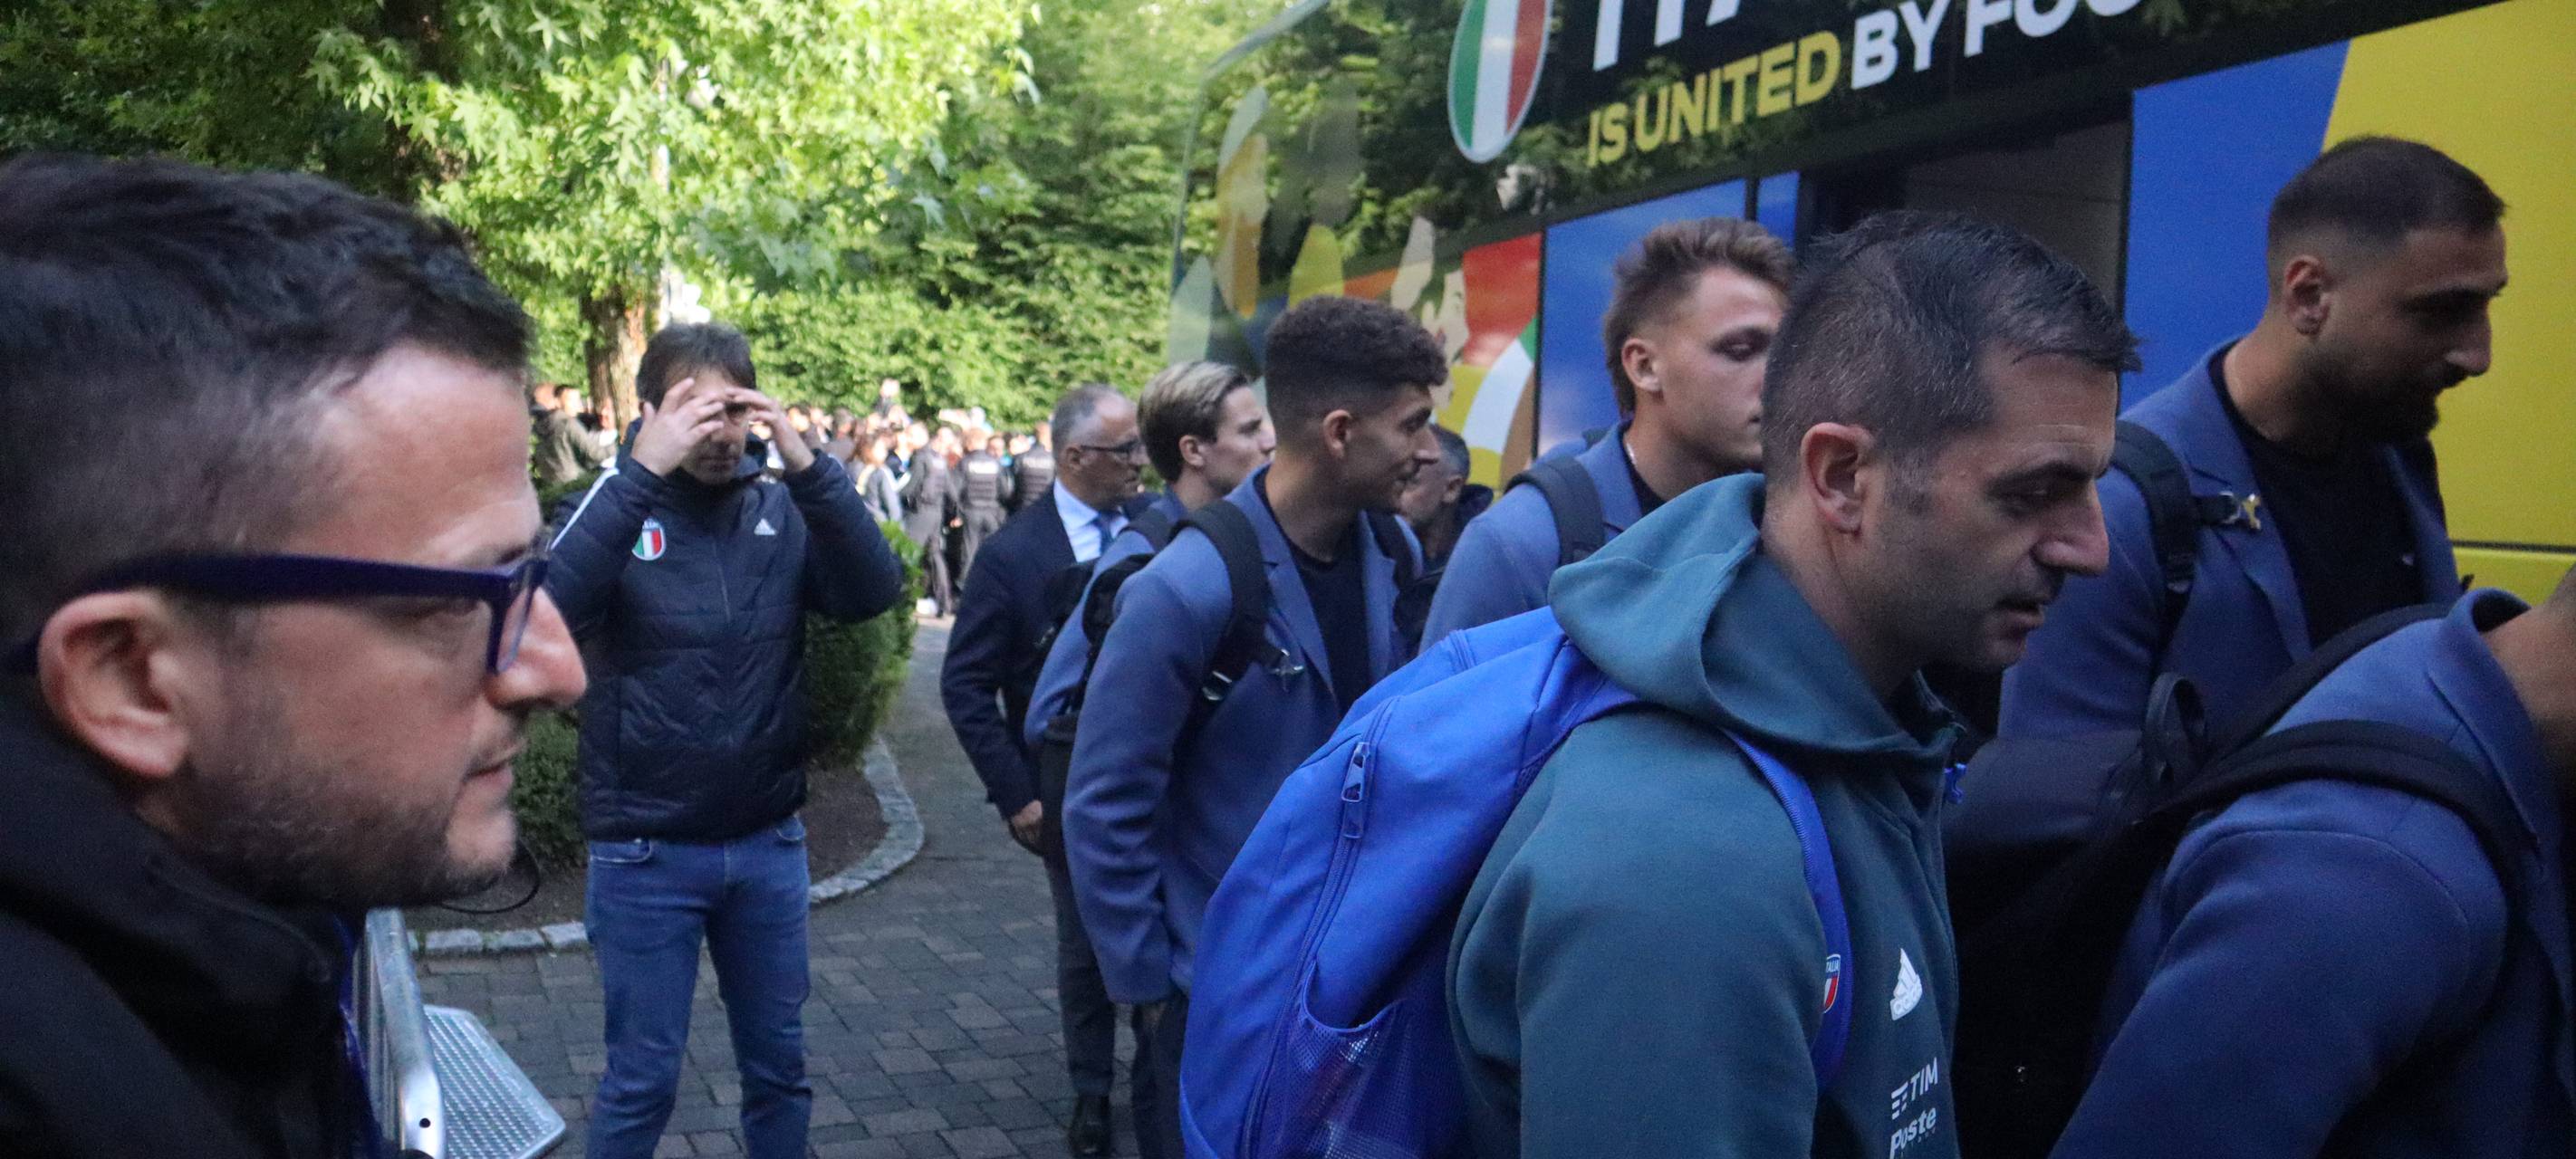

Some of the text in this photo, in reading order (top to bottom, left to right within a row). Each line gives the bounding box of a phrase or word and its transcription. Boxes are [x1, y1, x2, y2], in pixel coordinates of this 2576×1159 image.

[1588, 102, 1629, 168] IS
[1634, 30, 1841, 152] UNITED
[1850, 0, 1948, 90] BY
[1910, 1057, 1938, 1102] TIM
[1889, 1107, 1937, 1159] Poste
